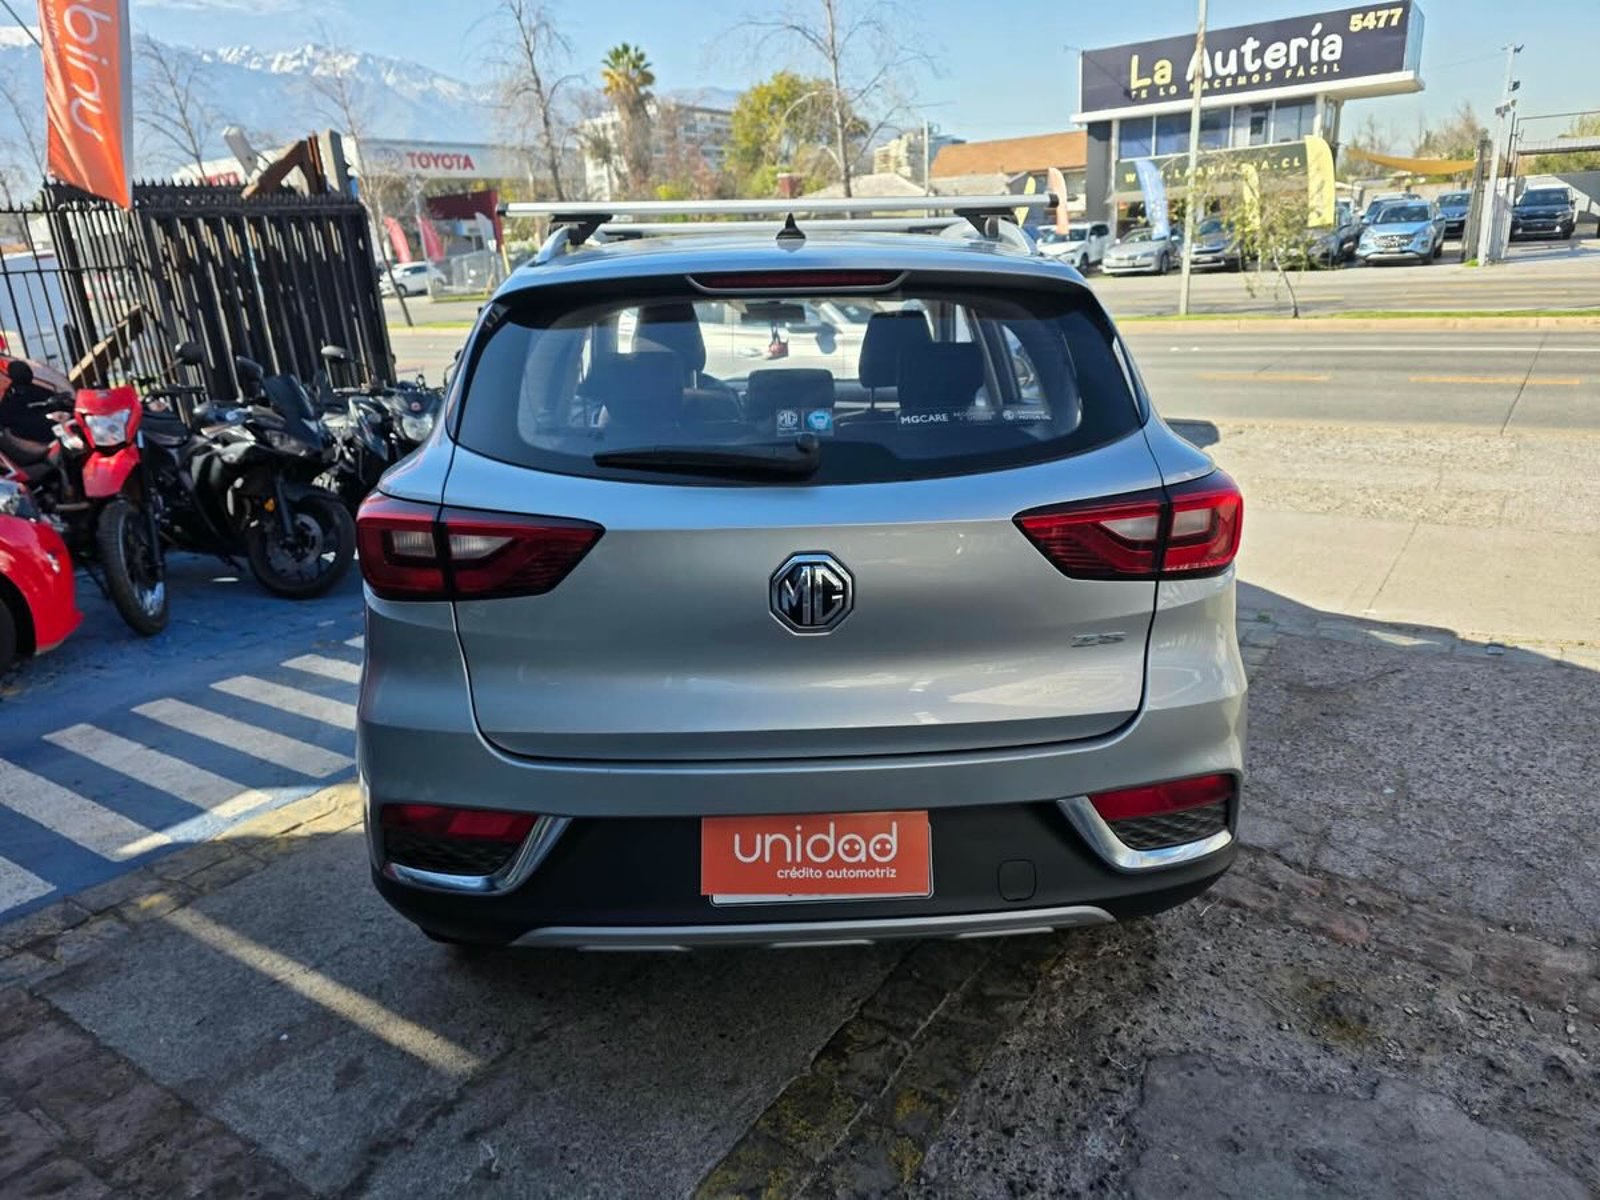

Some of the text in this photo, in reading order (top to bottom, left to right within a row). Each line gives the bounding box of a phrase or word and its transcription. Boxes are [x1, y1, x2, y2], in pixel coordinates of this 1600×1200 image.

[1349, 7, 1403, 32] 5477
[1130, 22, 1343, 89] La Autería
[1159, 85, 1177, 96] LO
[406, 152, 476, 171] TOYOTA
[900, 413, 949, 424] MGCARE
[778, 562, 847, 628] MG
[734, 821, 898, 864] unidad
[777, 866, 897, 879] crédito automotriz
